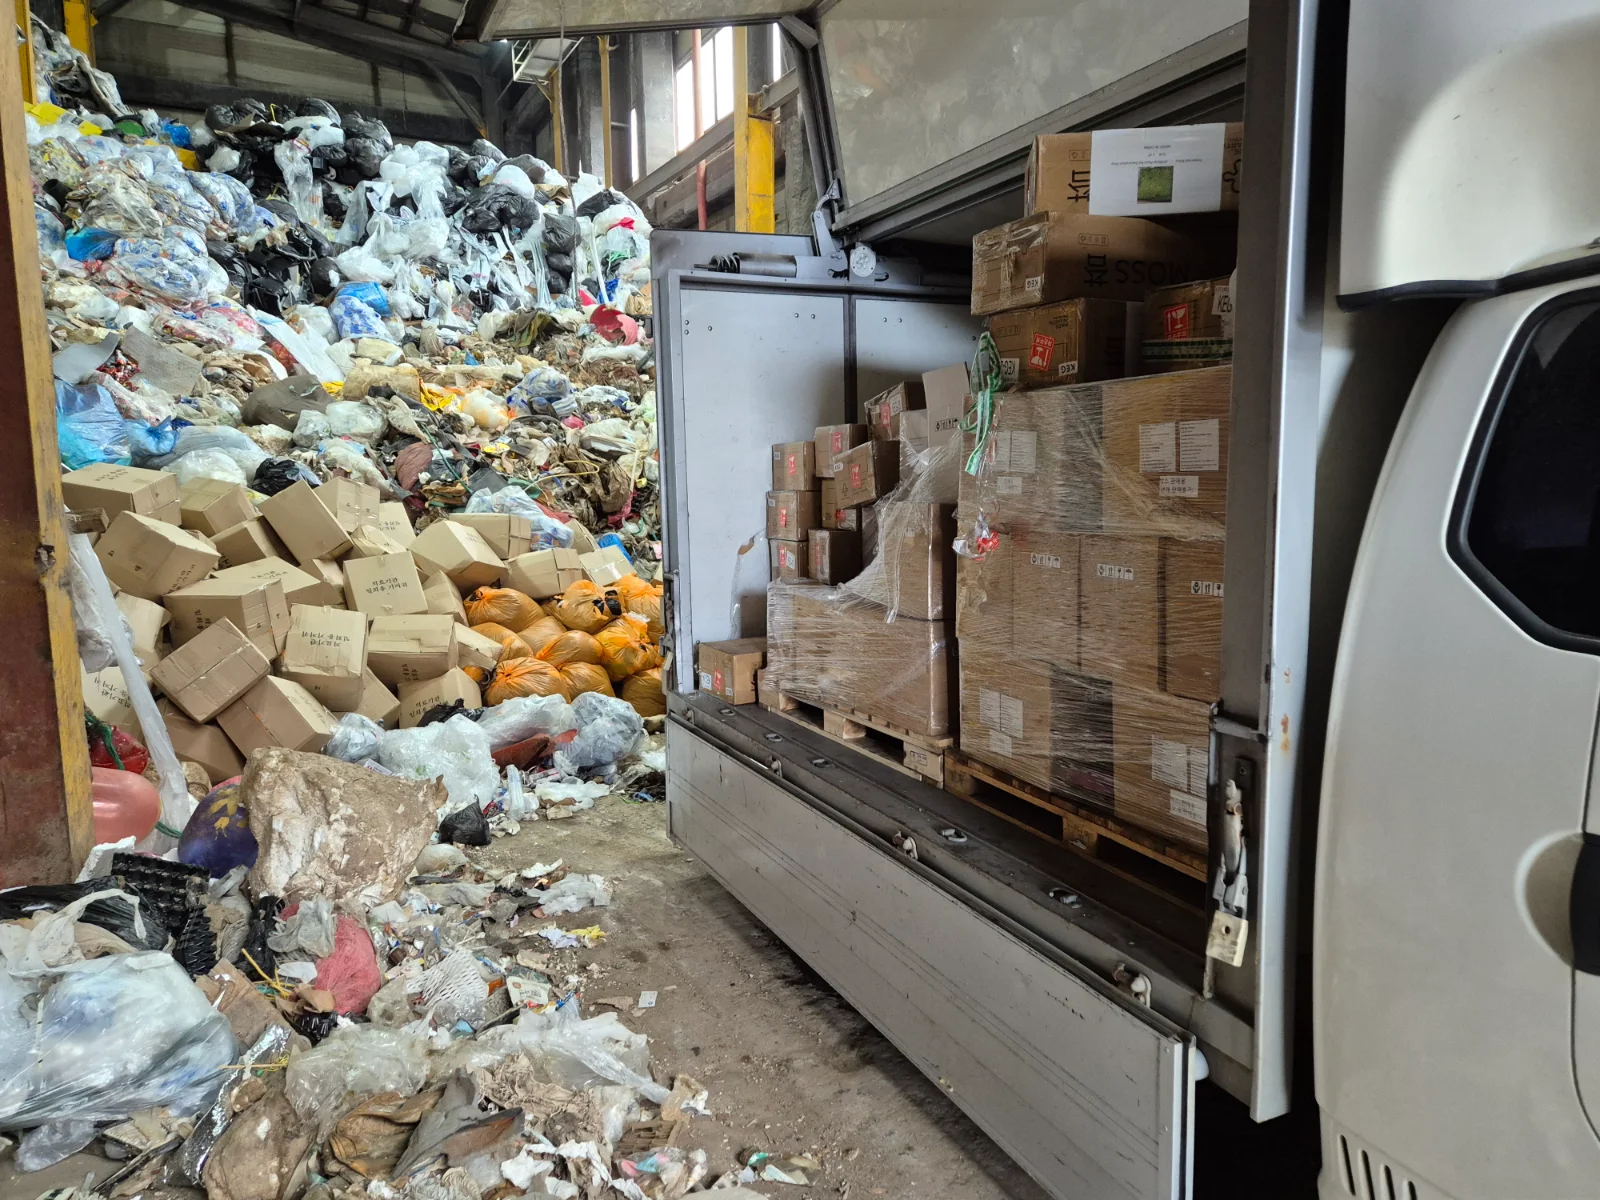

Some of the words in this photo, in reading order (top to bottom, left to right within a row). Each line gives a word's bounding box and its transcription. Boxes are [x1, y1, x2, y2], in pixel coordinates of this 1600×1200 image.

[1083, 253, 1108, 287] 苔
[1115, 259, 1188, 286] MOSS
[1026, 279, 1039, 288] KEG
[1060, 364, 1076, 374] KEG
[372, 577, 398, 586] 의료기관
[366, 585, 386, 594] 일회용
[301, 630, 325, 639] 기저귀
[327, 634, 350, 642] 일회용
[309, 639, 341, 647] 의료기관
[415, 695, 440, 708] 의료기관
